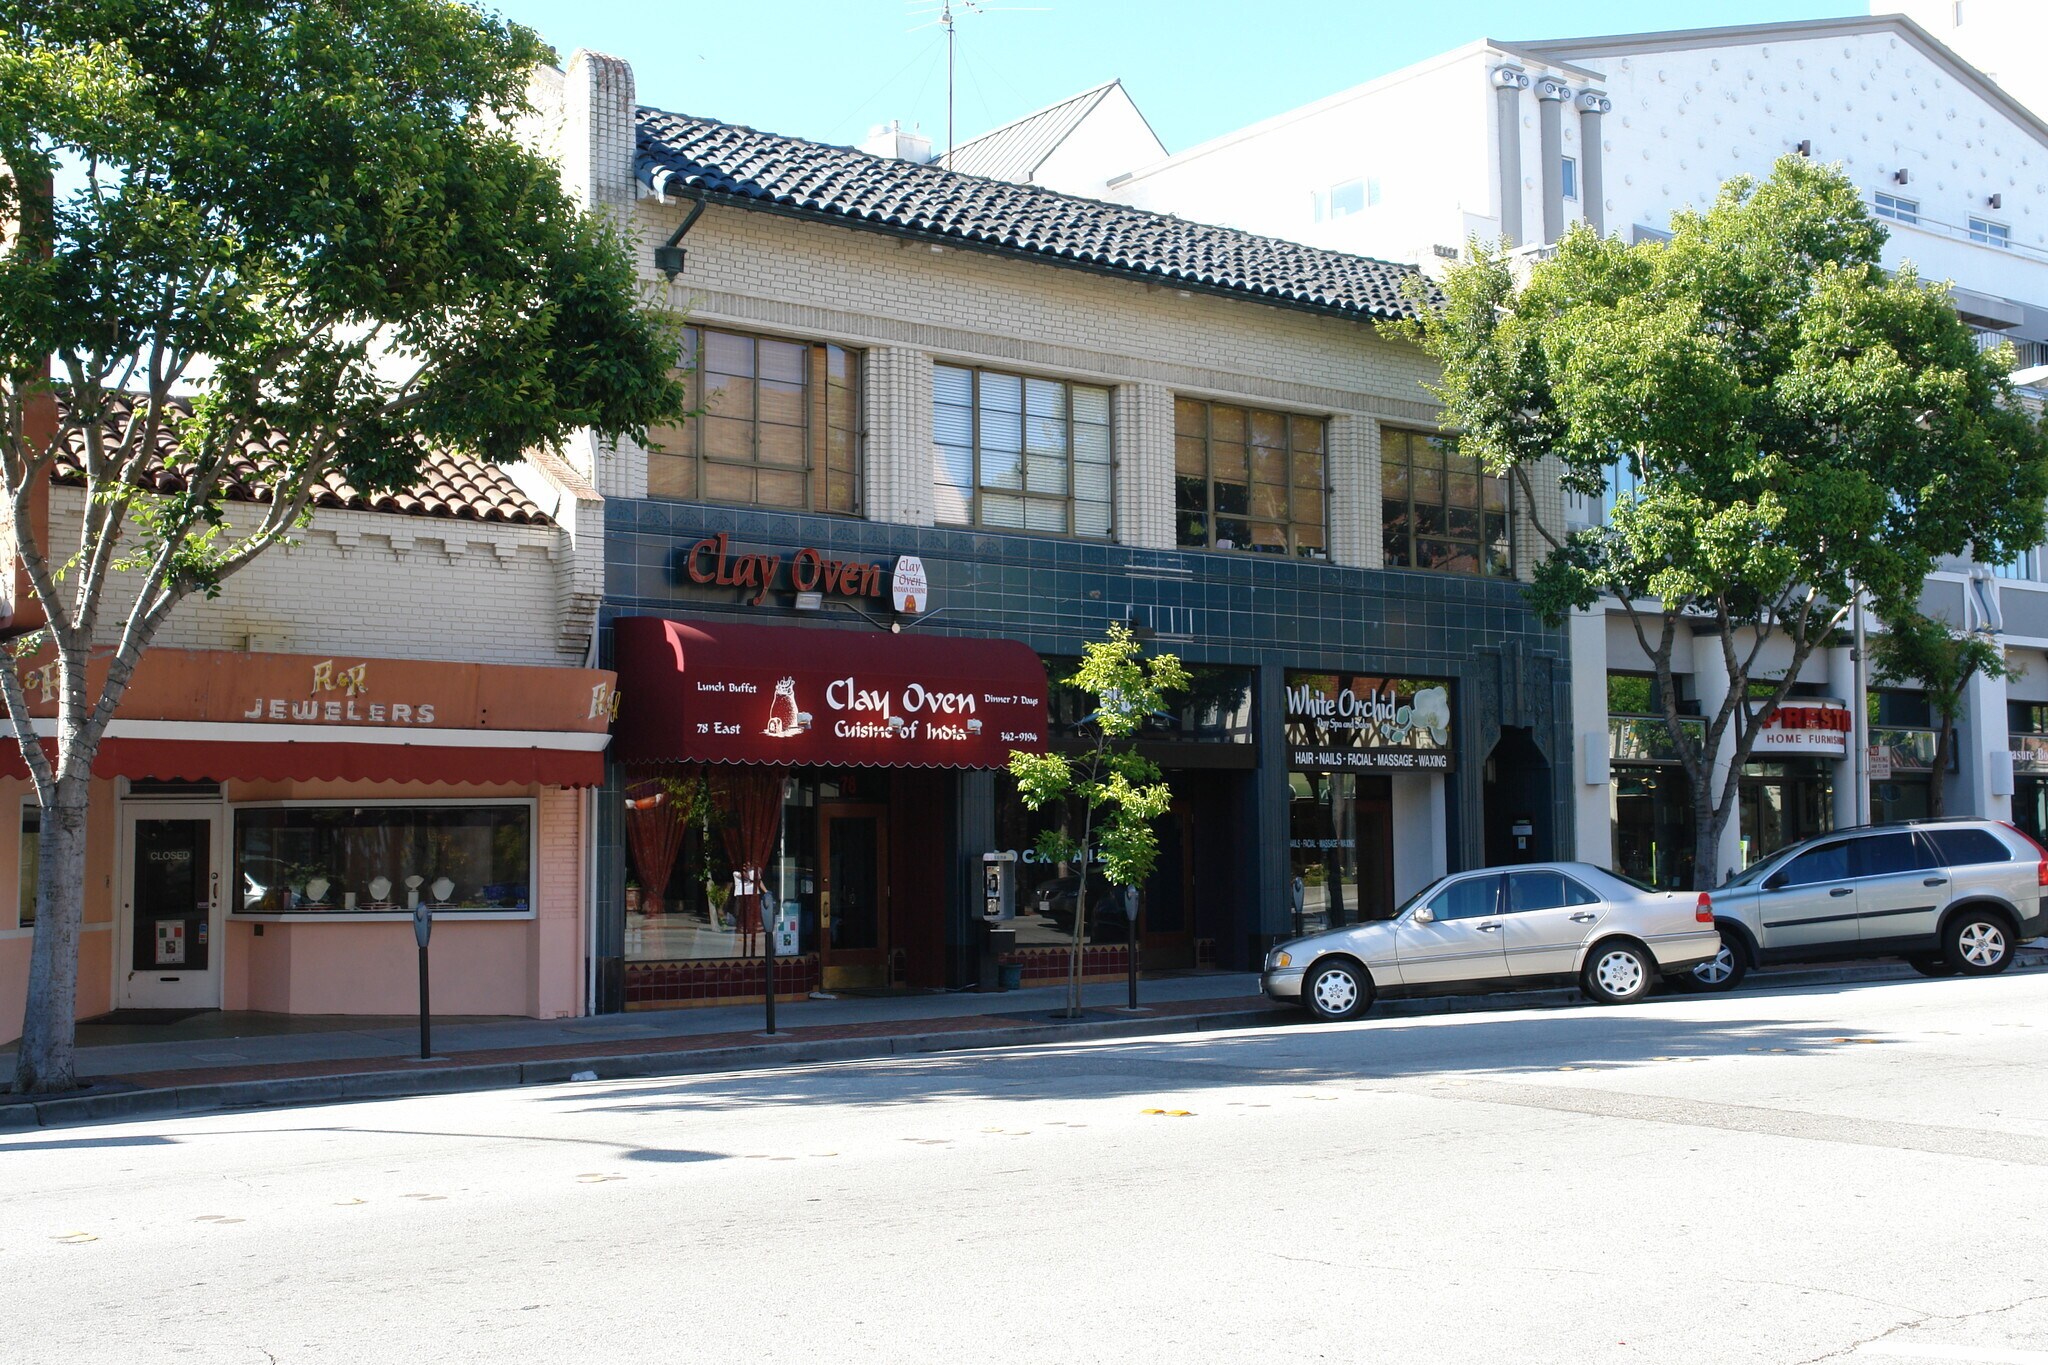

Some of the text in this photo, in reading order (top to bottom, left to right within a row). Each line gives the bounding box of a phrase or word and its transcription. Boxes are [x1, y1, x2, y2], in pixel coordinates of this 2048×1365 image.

[688, 533, 881, 606] Clay Oven
[899, 559, 921, 586] Clay Oven
[311, 659, 369, 697] R&R
[697, 682, 757, 693] Lunch Buffet
[826, 677, 976, 720] Clay Oven
[984, 694, 1038, 706] Dinner 7 Days
[1286, 684, 1396, 722] White Orchid
[244, 698, 435, 723] JEWELERS
[697, 721, 741, 735] 78 East
[834, 720, 967, 741] Cuisine of India
[1317, 717, 1371, 732] Day Spa and Salon
[1000, 731, 1038, 742] 342-9194
[1767, 734, 1802, 744] HOME
[1295, 752, 1447, 767] HAIR NAILS FACIAL MASSAGE WAXING
[2011, 750, 2034, 760] asure
[150, 851, 190, 860] CLOSED
